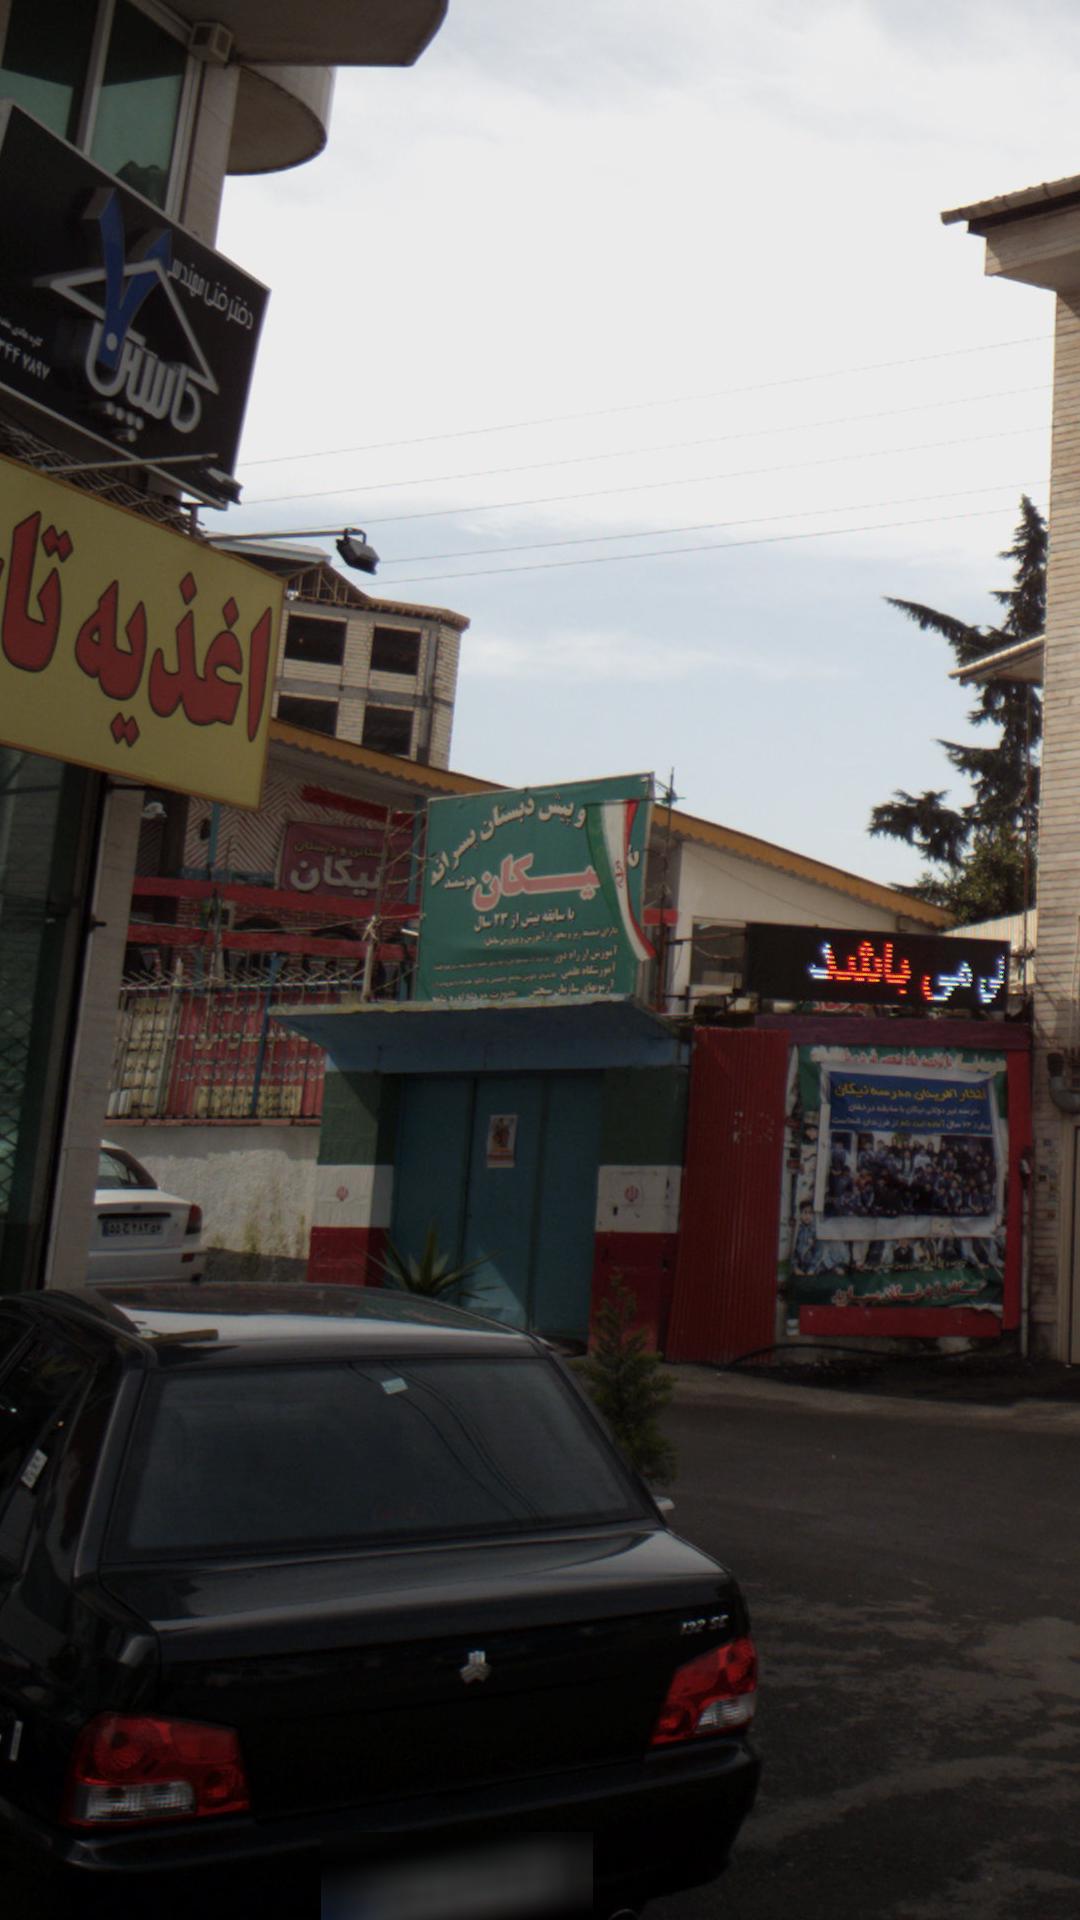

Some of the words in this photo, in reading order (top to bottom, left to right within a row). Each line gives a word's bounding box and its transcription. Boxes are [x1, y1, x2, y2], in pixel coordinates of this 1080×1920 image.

[203, 281, 229, 311] فنی
[226, 295, 254, 330] دفتر
[75, 571, 272, 748] اغذیه
[480, 797, 536, 841] دبستان
[537, 792, 575, 826] پیش
[474, 914, 493, 933] سال
[511, 911, 520, 930] از
[520, 912, 542, 930] بیش
[542, 908, 567, 923] سابقه
[567, 906, 576, 921] با
[809, 940, 912, 994] باشد
